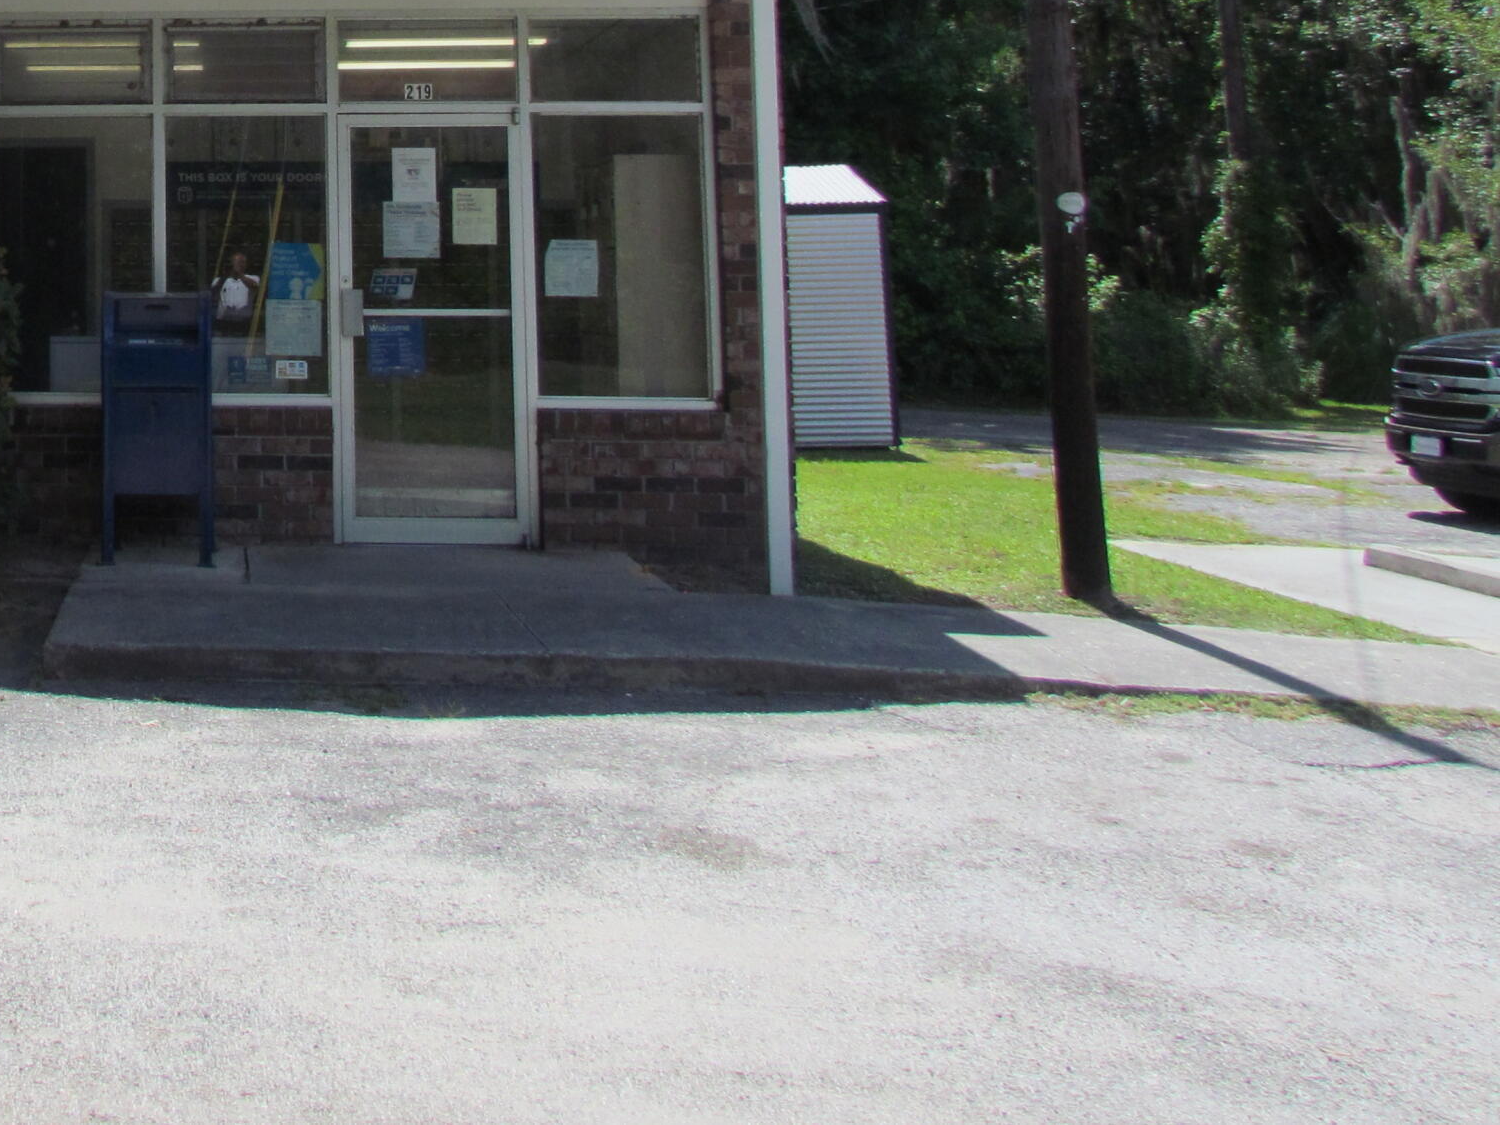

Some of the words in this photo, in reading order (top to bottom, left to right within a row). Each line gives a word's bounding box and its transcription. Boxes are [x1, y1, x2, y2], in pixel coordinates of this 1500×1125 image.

[406, 84, 431, 99] 219
[177, 172, 205, 183] THIS
[207, 172, 233, 183] BOX
[235, 171, 247, 182] IS
[250, 171, 283, 182] YOUR
